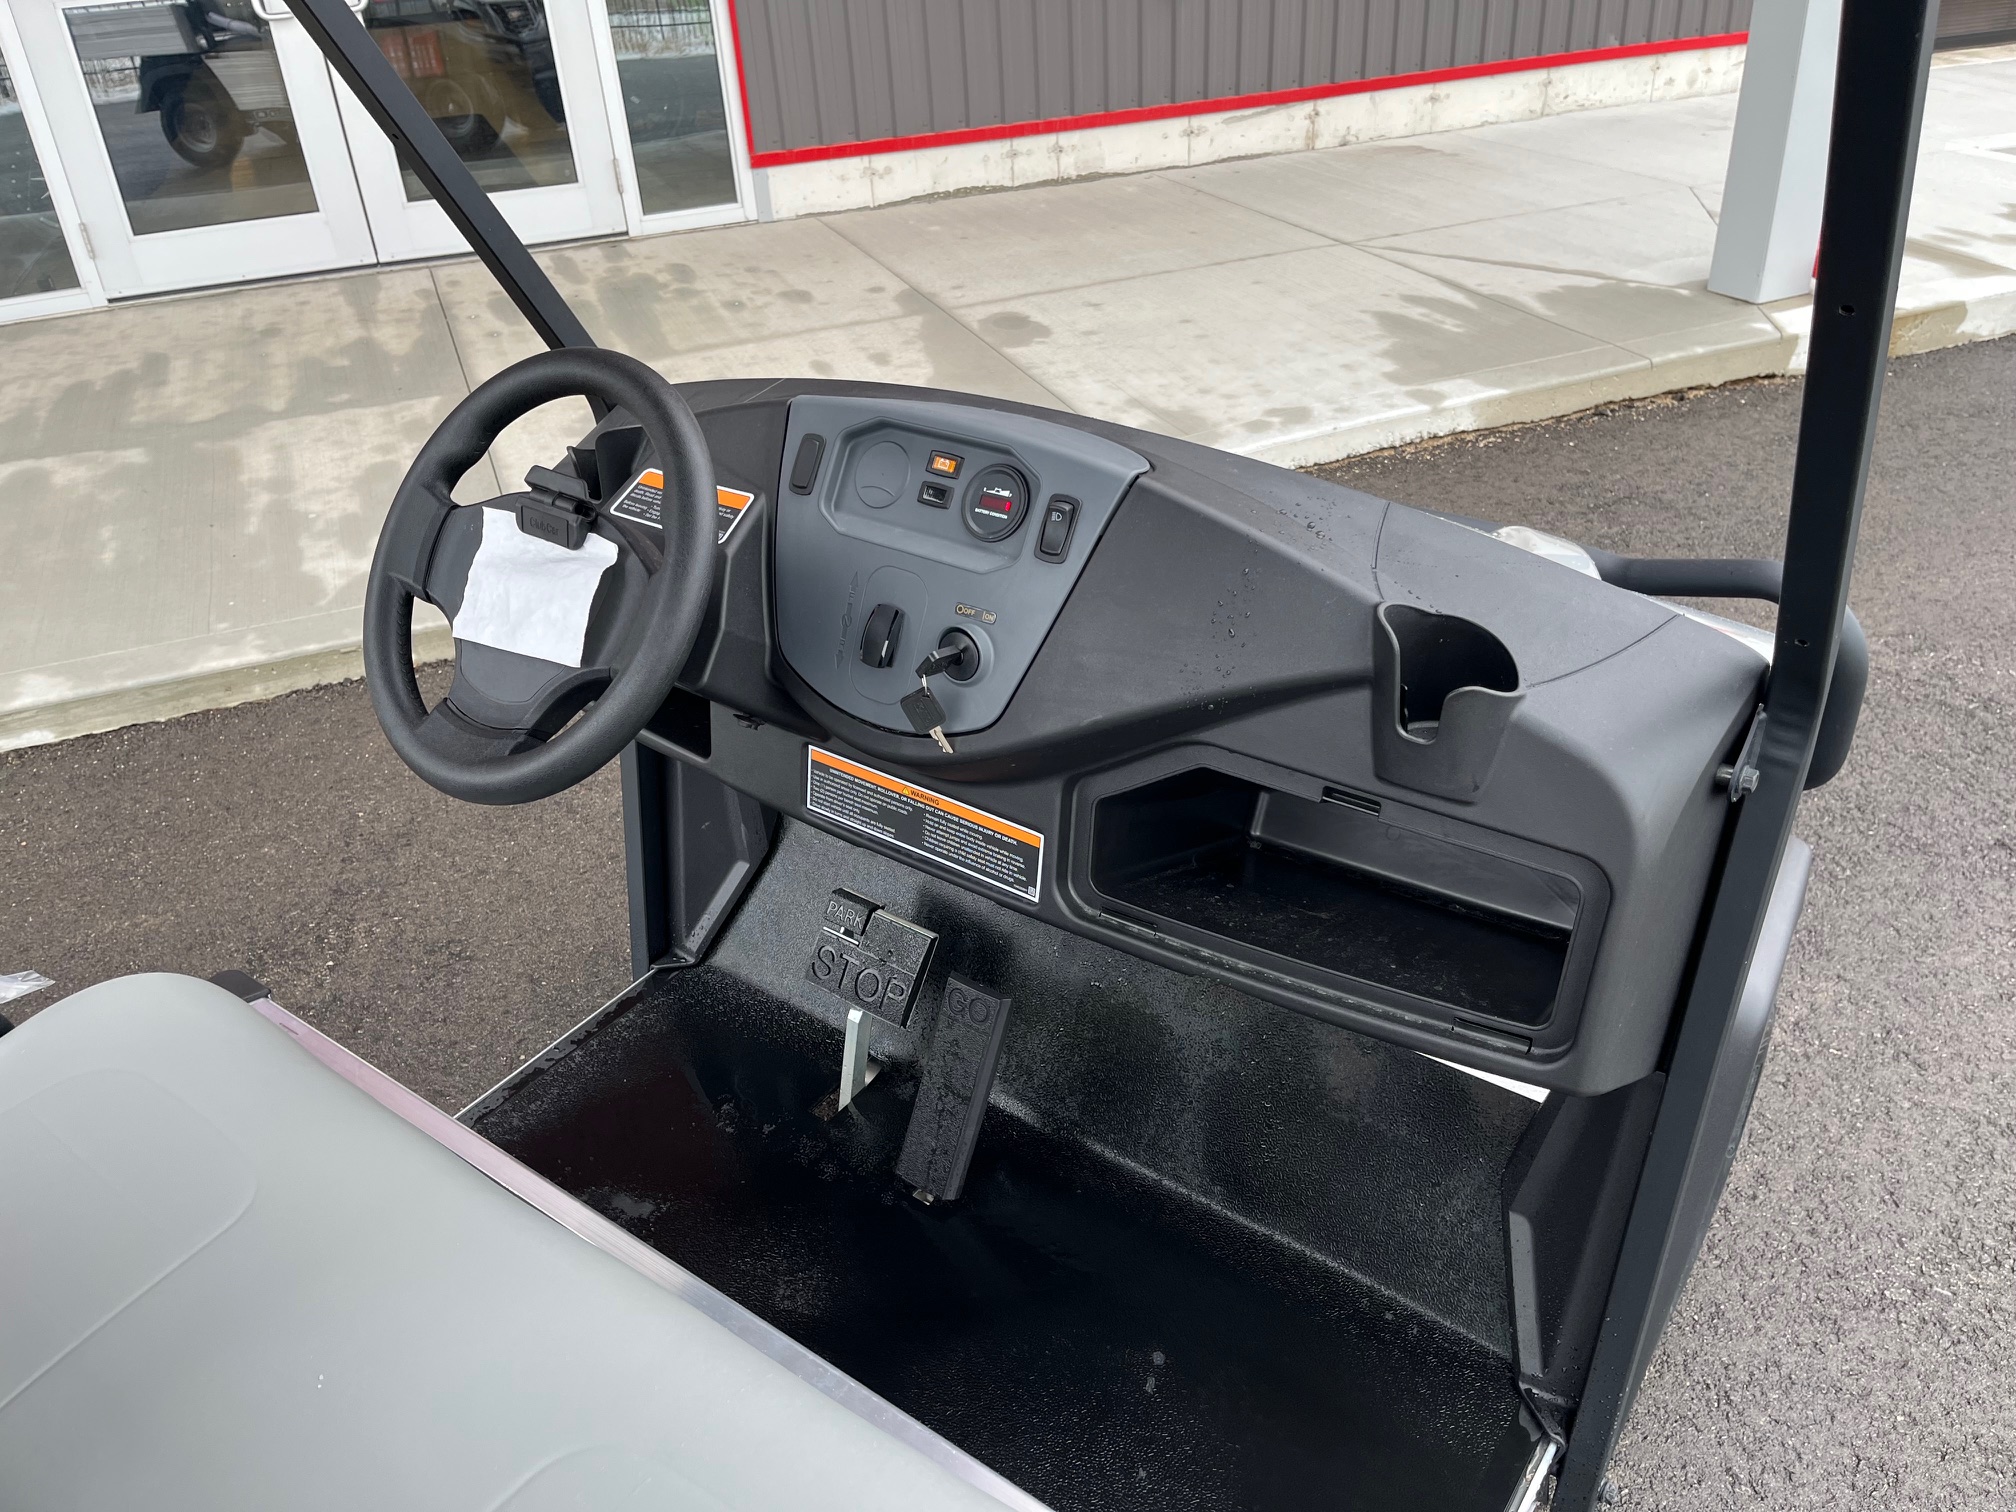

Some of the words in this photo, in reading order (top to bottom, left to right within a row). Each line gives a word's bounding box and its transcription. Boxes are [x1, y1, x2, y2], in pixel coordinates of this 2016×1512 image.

[910, 790, 939, 806] WARNING
[907, 798, 925, 809] FALLING
[944, 812, 958, 822] CAUSE
[959, 818, 978, 830] SERIOUS
[978, 826, 994, 836] INJURY
[826, 901, 868, 929] PARK
[812, 945, 906, 1009] STOP
[948, 987, 989, 1024] GO
